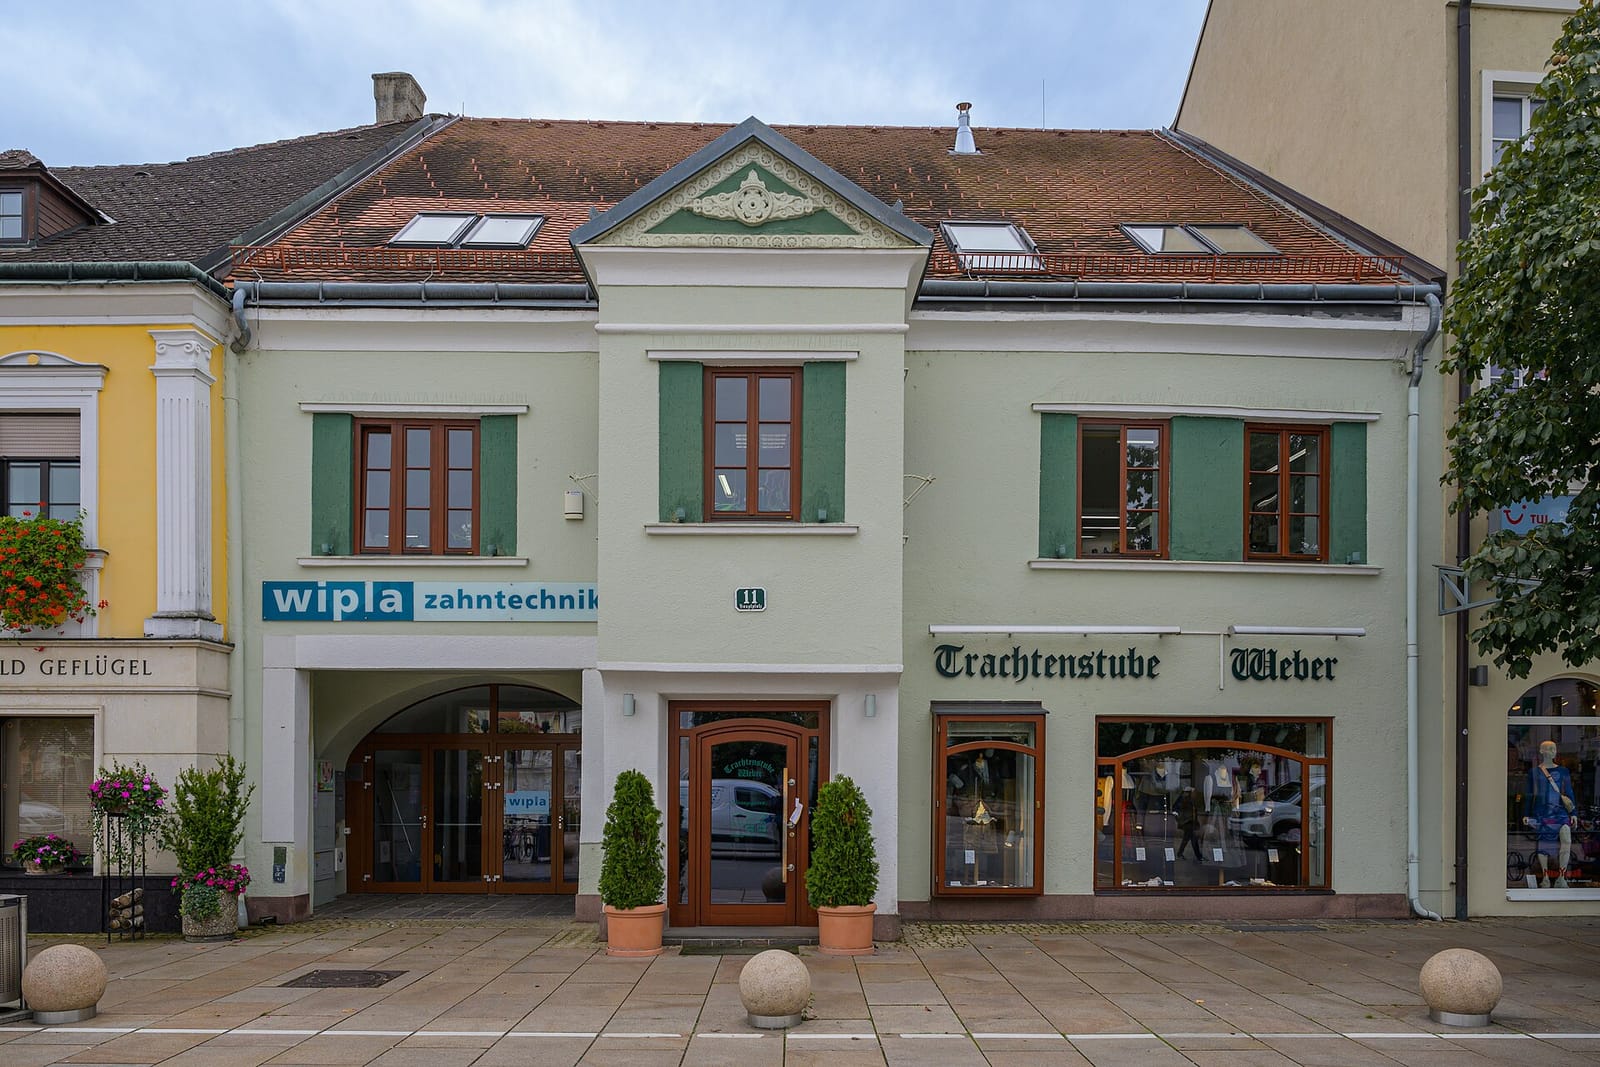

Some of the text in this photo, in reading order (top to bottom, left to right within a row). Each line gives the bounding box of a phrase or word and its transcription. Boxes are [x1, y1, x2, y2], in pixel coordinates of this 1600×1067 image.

[273, 581, 598, 621] wipla zahntechnik
[743, 589, 759, 604] 11
[39, 654, 153, 676] GEFLÜGEL
[933, 644, 1338, 683] Trachtenstube Weber
[508, 796, 547, 809] wipla
